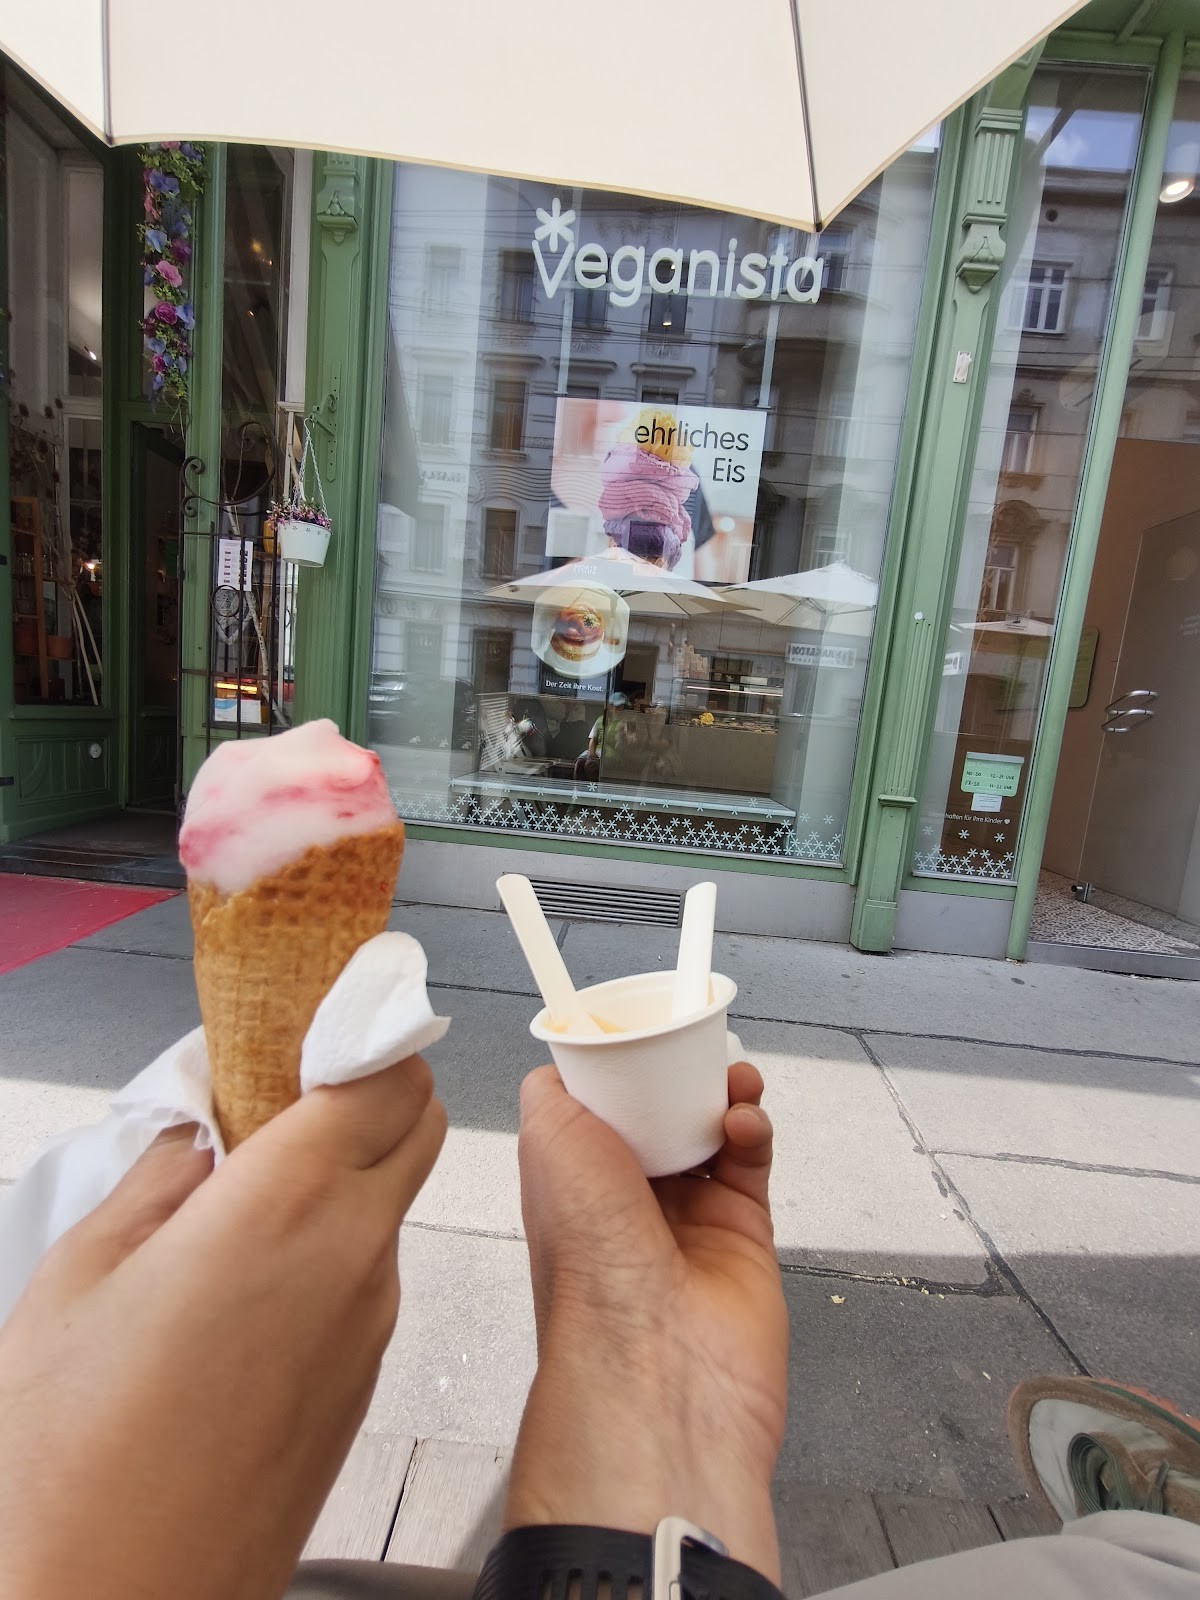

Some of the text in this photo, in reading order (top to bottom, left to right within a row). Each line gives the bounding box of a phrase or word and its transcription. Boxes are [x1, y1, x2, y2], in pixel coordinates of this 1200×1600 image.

[634, 418, 750, 451] ehrliches
[712, 457, 746, 483] Eis
[545, 680, 557, 688] Der
[558, 681, 572, 690] Zeit
[587, 684, 604, 692] Kost.
[944, 812, 963, 820] haften
[984, 817, 1003, 825] Kinder
